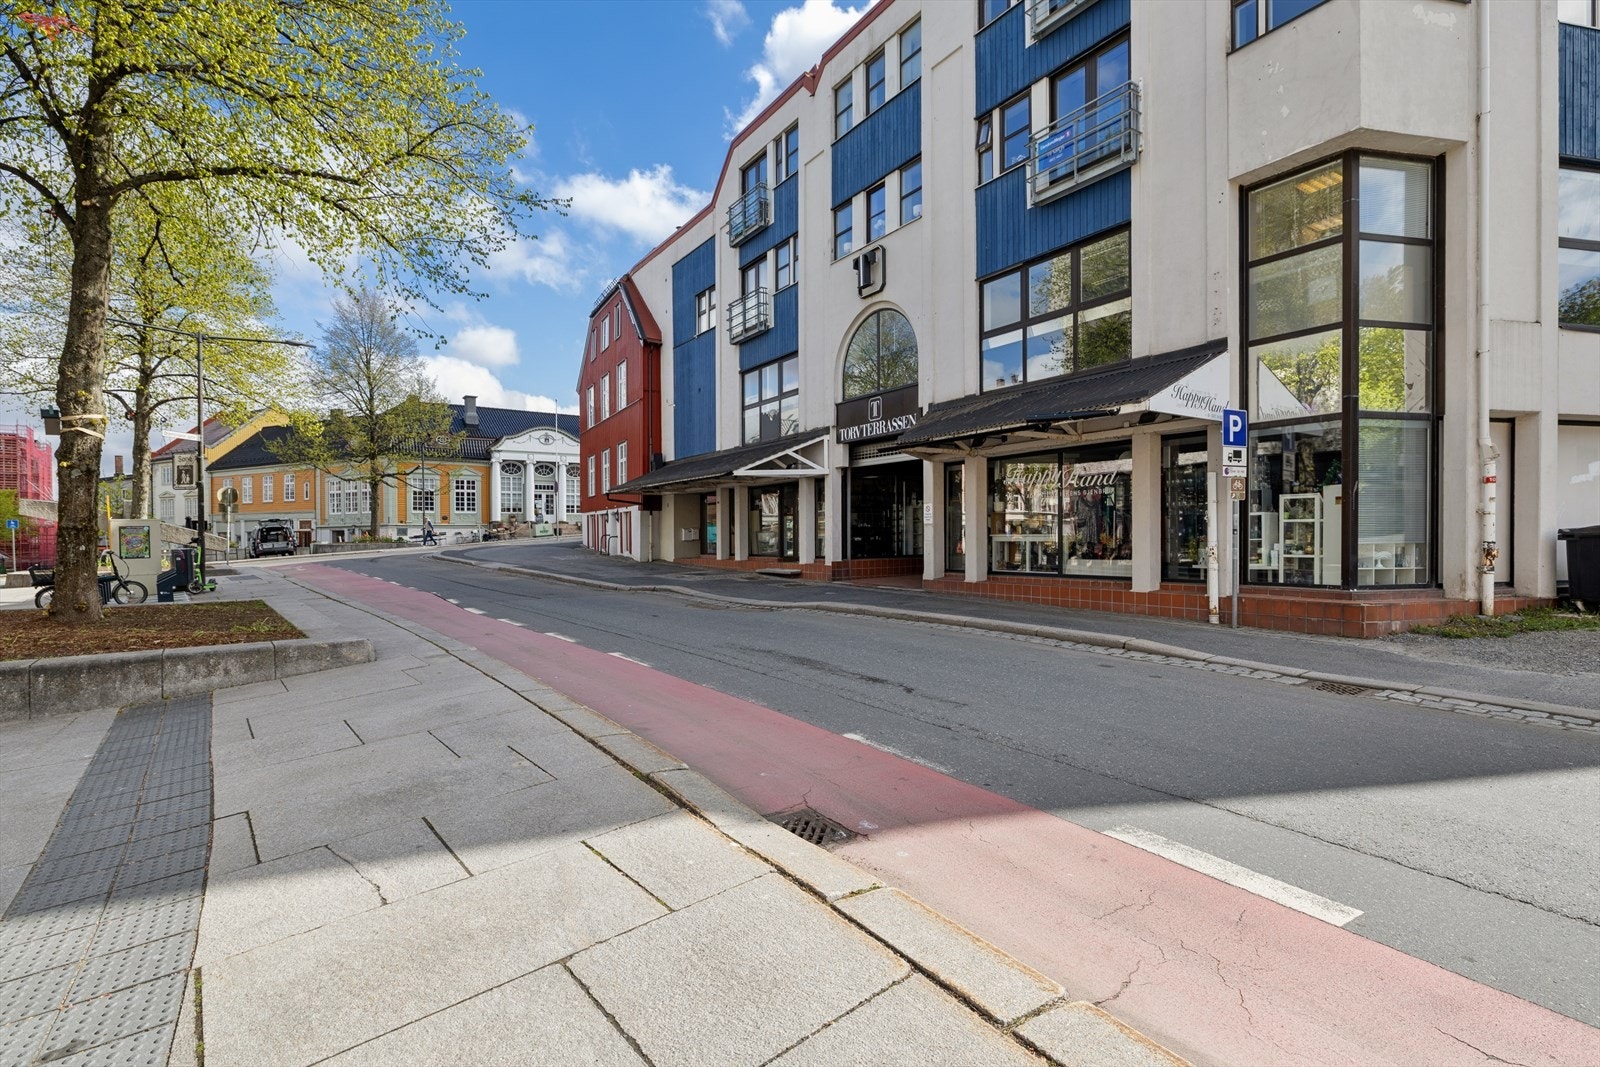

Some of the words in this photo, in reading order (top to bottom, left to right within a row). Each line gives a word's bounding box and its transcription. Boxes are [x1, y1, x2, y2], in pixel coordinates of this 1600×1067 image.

[870, 400, 879, 418] T
[1171, 385, 1204, 409] Happy
[1229, 414, 1243, 443] P
[1003, 466, 1062, 491] Happy
[1058, 467, 1119, 488] Hand
